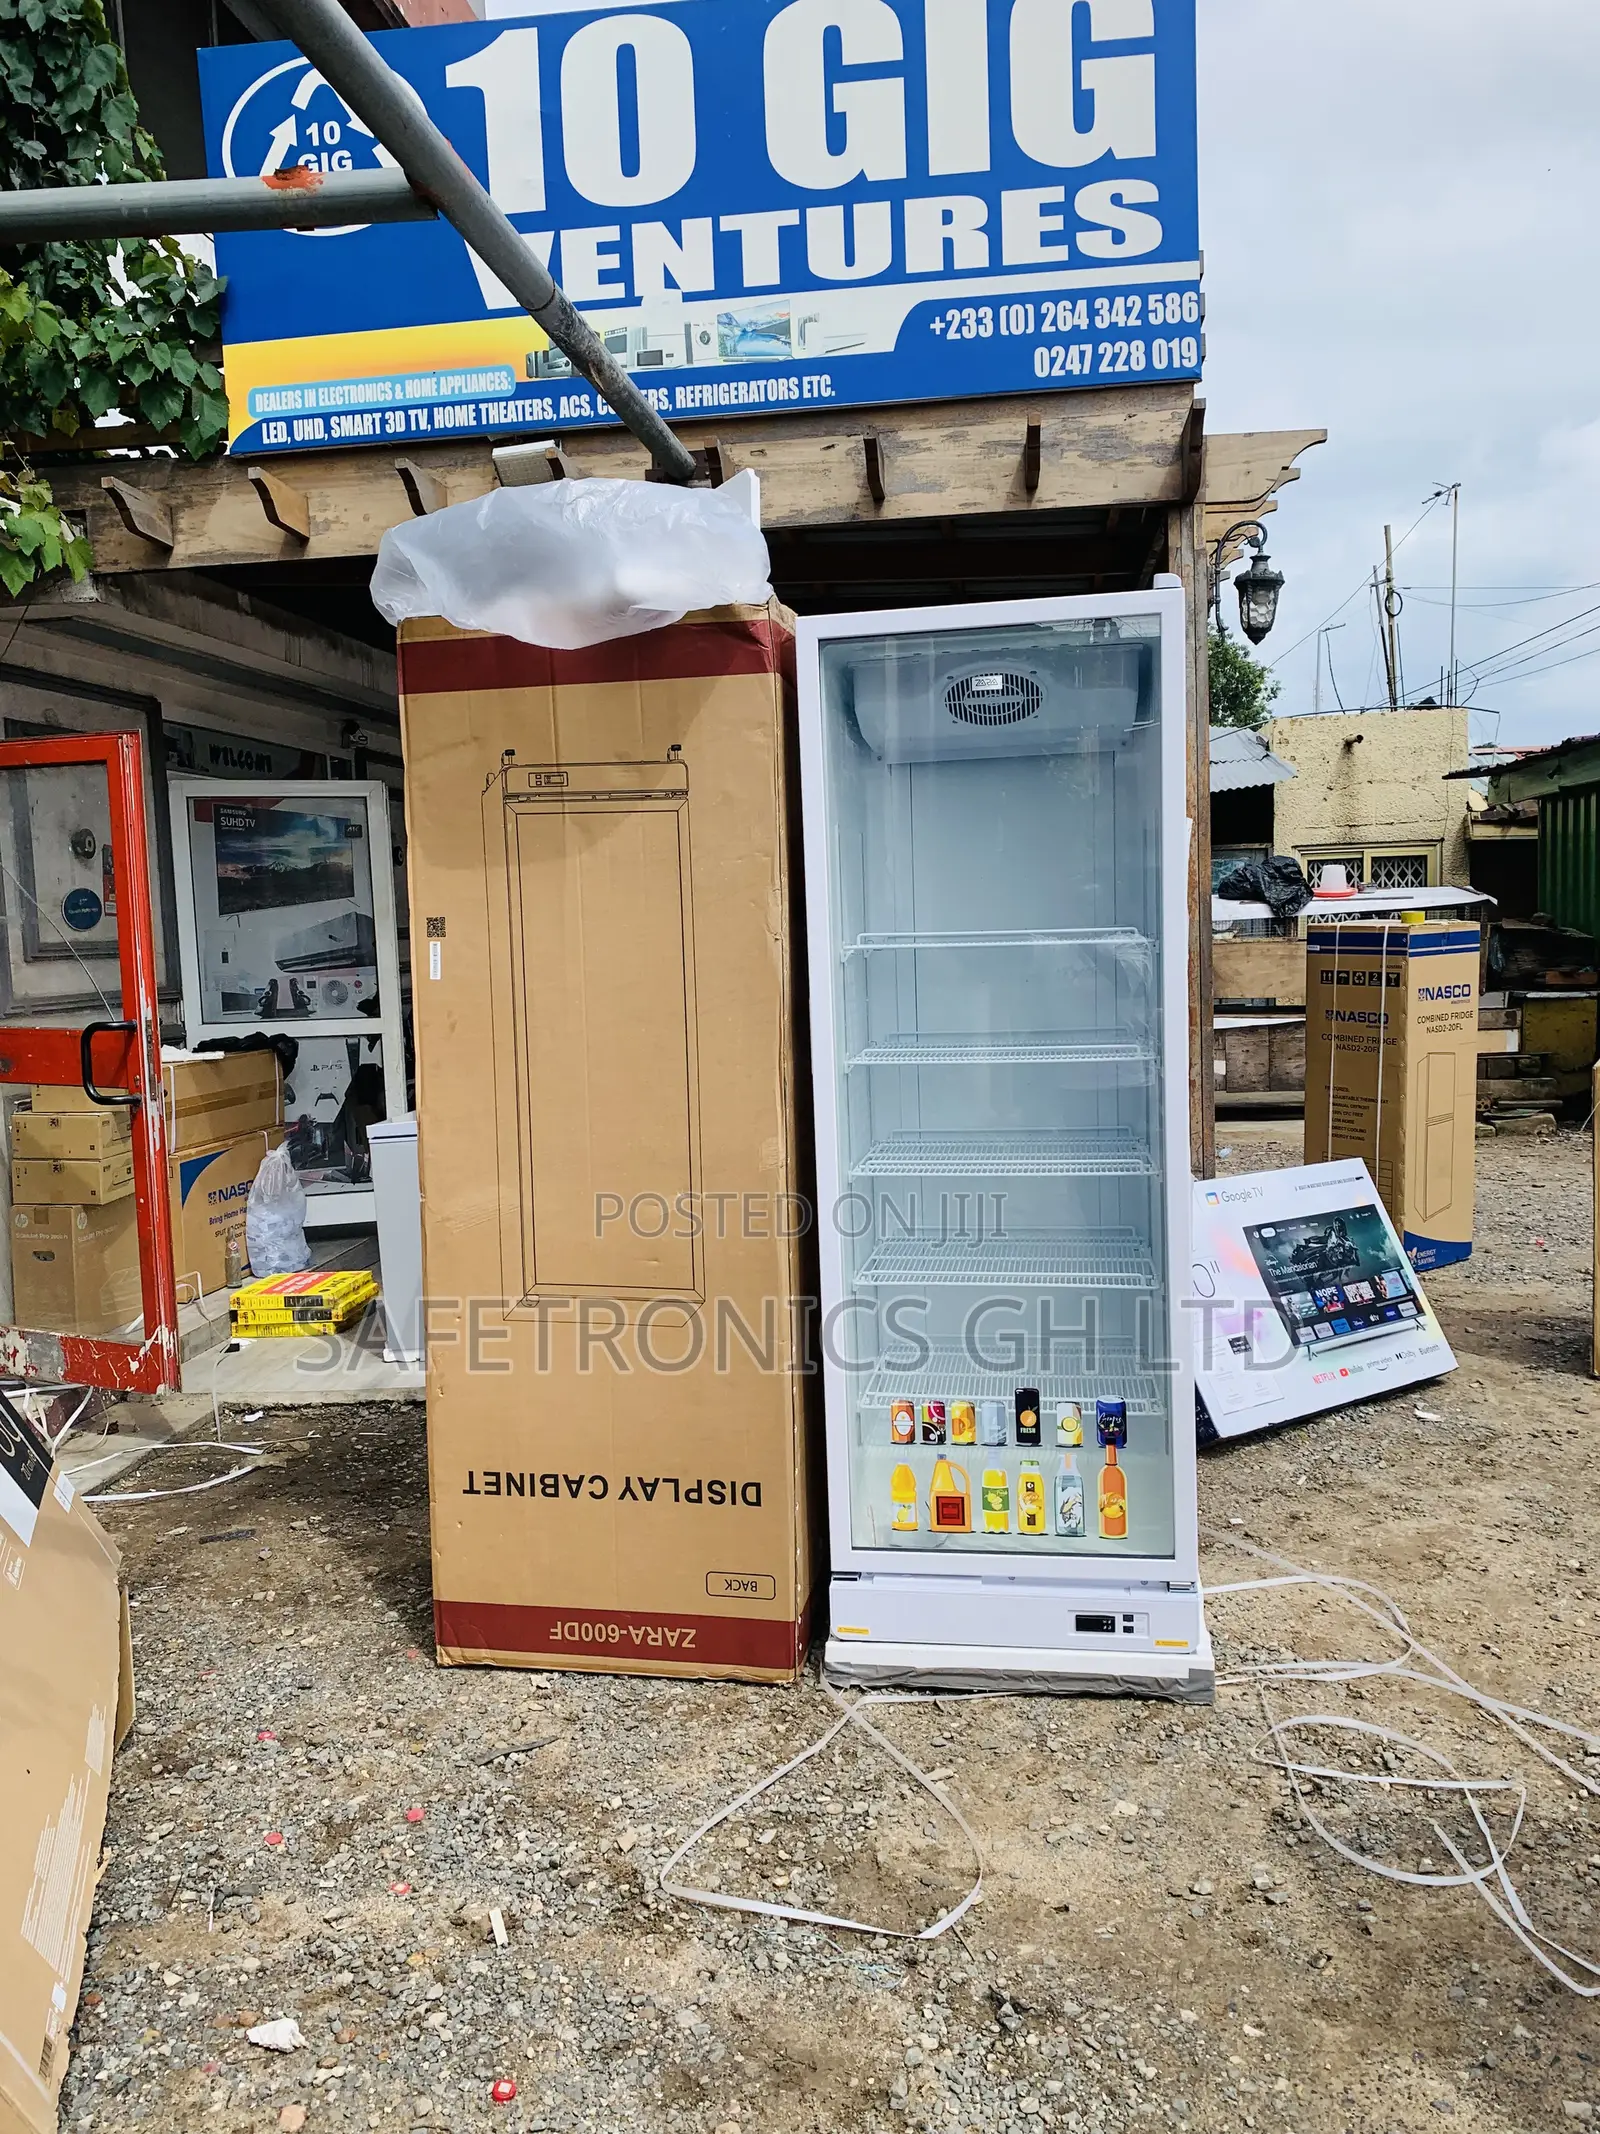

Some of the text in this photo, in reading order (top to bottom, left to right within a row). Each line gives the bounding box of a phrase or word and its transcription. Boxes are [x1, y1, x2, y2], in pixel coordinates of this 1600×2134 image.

[446, 0, 1156, 213] 10 GIG
[306, 121, 341, 146] 10
[297, 150, 353, 173] GIG
[464, 179, 1163, 310] VENTURES
[930, 291, 1199, 340] +233 (0) 264 342 586
[1034, 336, 1198, 378] 0247 228 019
[255, 371, 512, 413] DEALERS IN ELECTRONICS & HOME APPLIANCES:
[262, 421, 291, 444] LED,
[293, 418, 328, 441] UHD,
[331, 413, 381, 438] SMART
[385, 410, 405, 433] 3D
[408, 408, 431, 432] TV,
[434, 404, 475, 428] HOME
[478, 397, 557, 424] THEATERS,
[559, 394, 594, 418] ACS,
[675, 376, 800, 409] REFRIGERATORS
[802, 374, 836, 398] ETC.
[1425, 984, 1471, 1001] NASCO
[1335, 1010, 1389, 1025] NASCO
[1417, 1010, 1474, 1025] COMBINED FRIDGE
[1426, 1023, 1463, 1034] NASD2-20FL
[1321, 1033, 1364, 1044] COMBINED
[219, 1179, 255, 1203] NASC
[1221, 1186, 1264, 1203] Google TV
[1268, 1261, 1319, 1277] The Mandalorian
[1315, 1285, 1338, 1297] NOPE
[1312, 1371, 1337, 1385] NETFLIX
[462, 1471, 762, 1507] DISPLAY CABINET
[724, 1579, 757, 1592] BACK
[550, 1621, 697, 1648] ZARA-600DF
